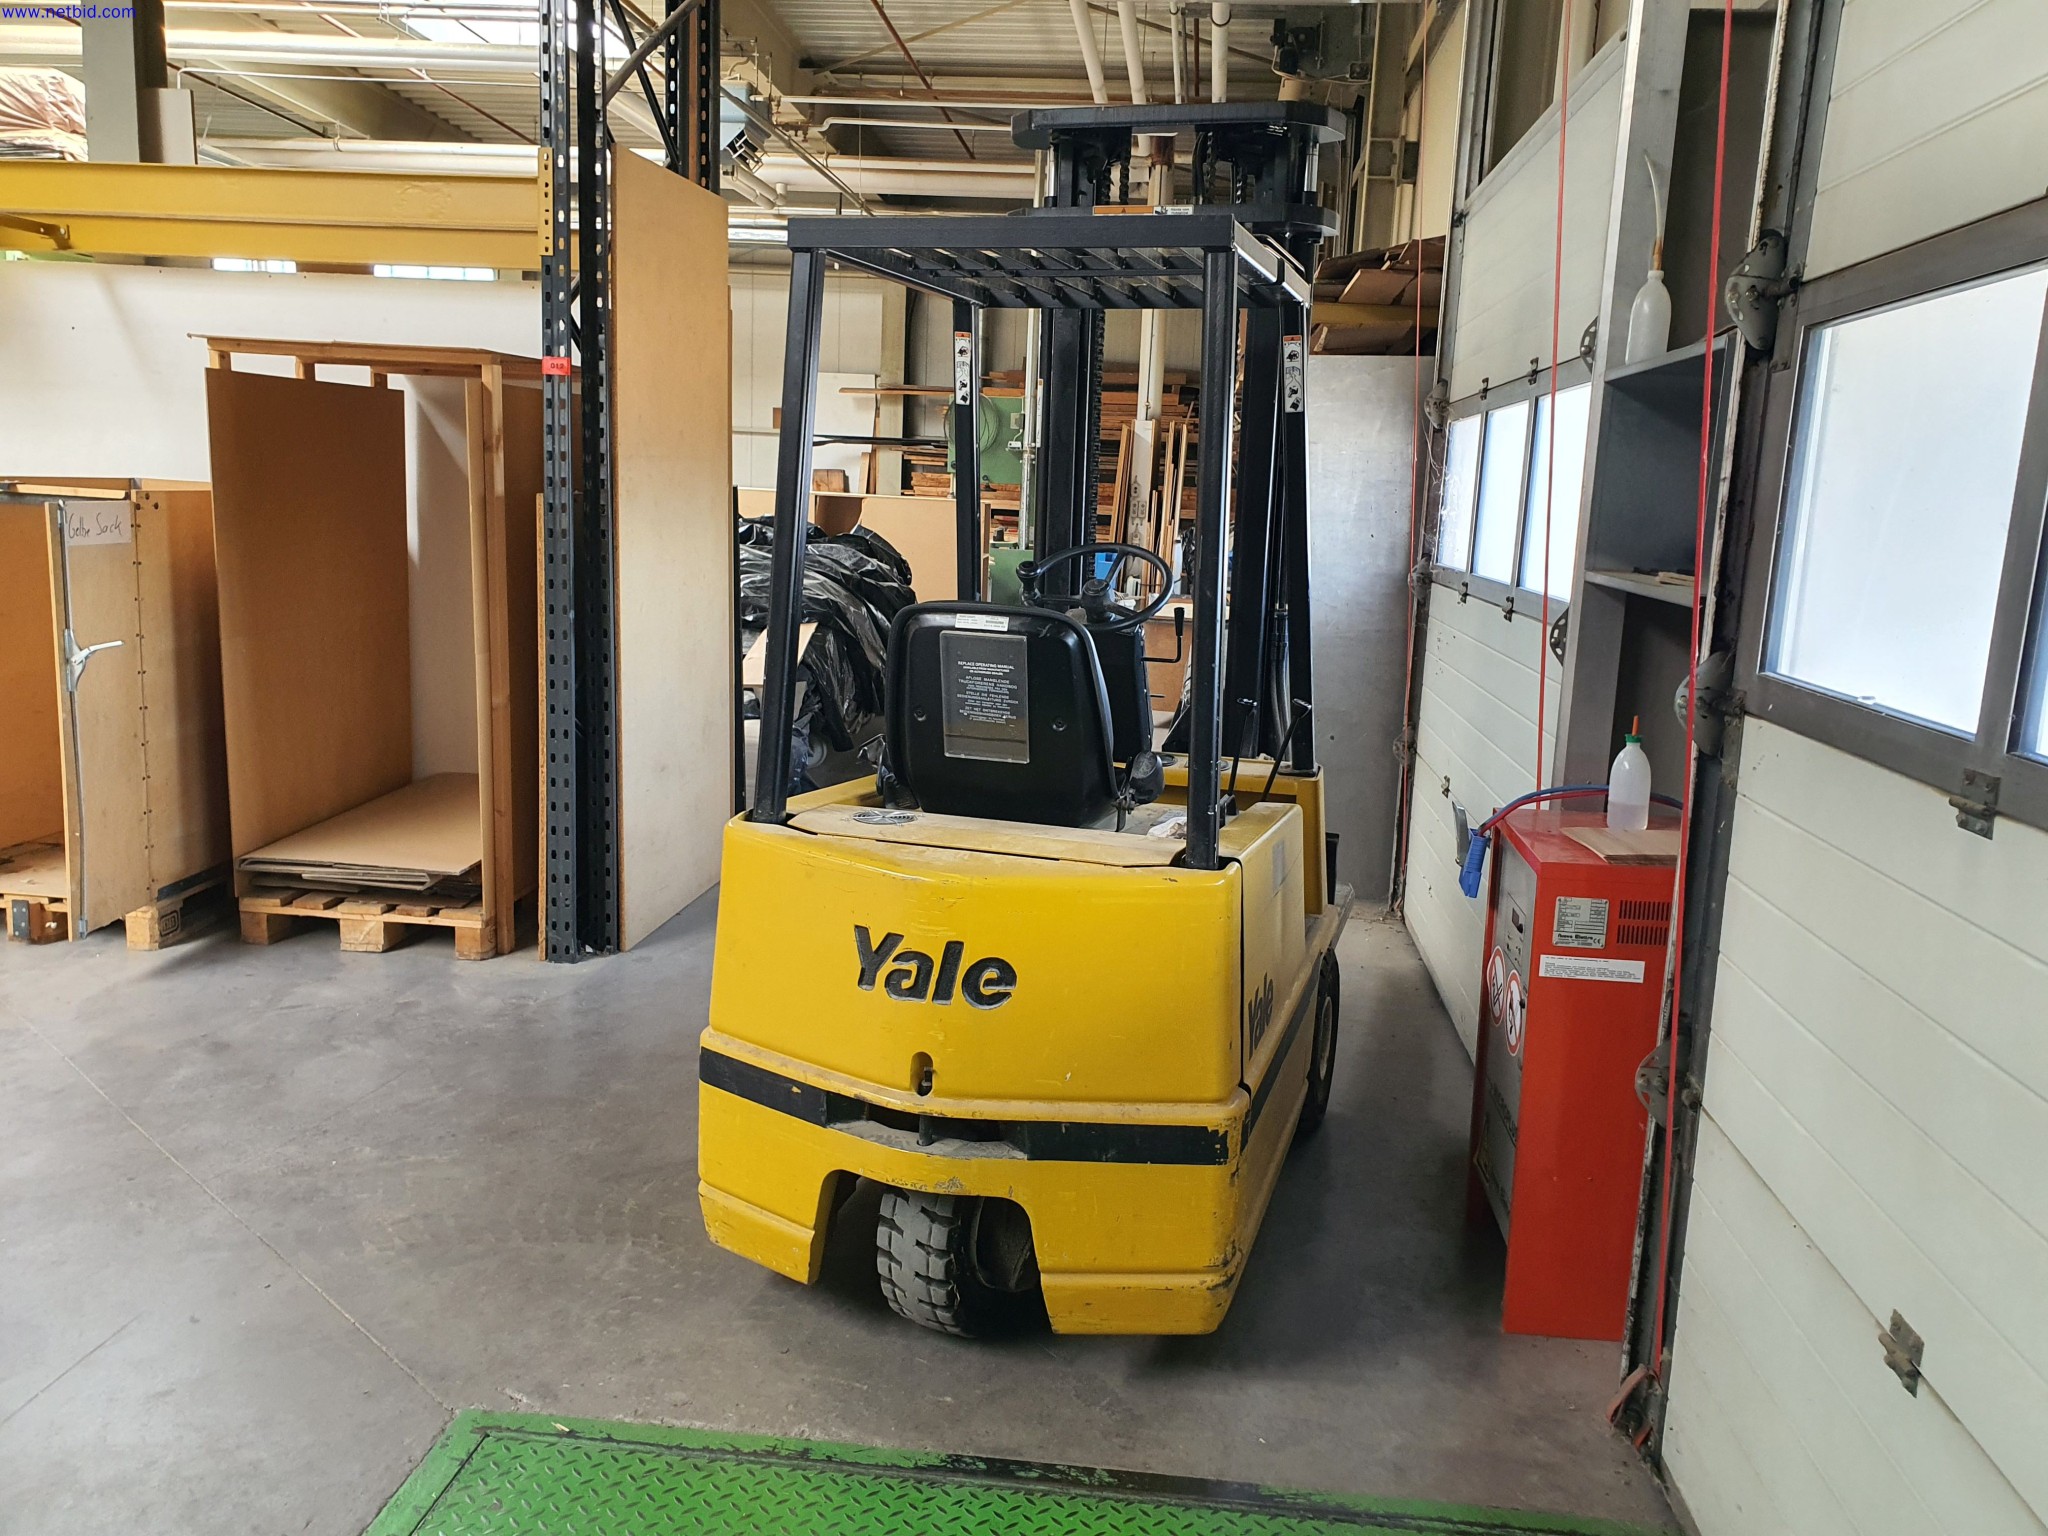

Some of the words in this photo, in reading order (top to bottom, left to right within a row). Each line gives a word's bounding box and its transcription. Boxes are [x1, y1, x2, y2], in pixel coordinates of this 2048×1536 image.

[68, 512, 91, 539] Gelbe
[95, 512, 123, 536] Sack
[854, 924, 1018, 1010] Yale
[1248, 971, 1274, 1060] Yale
